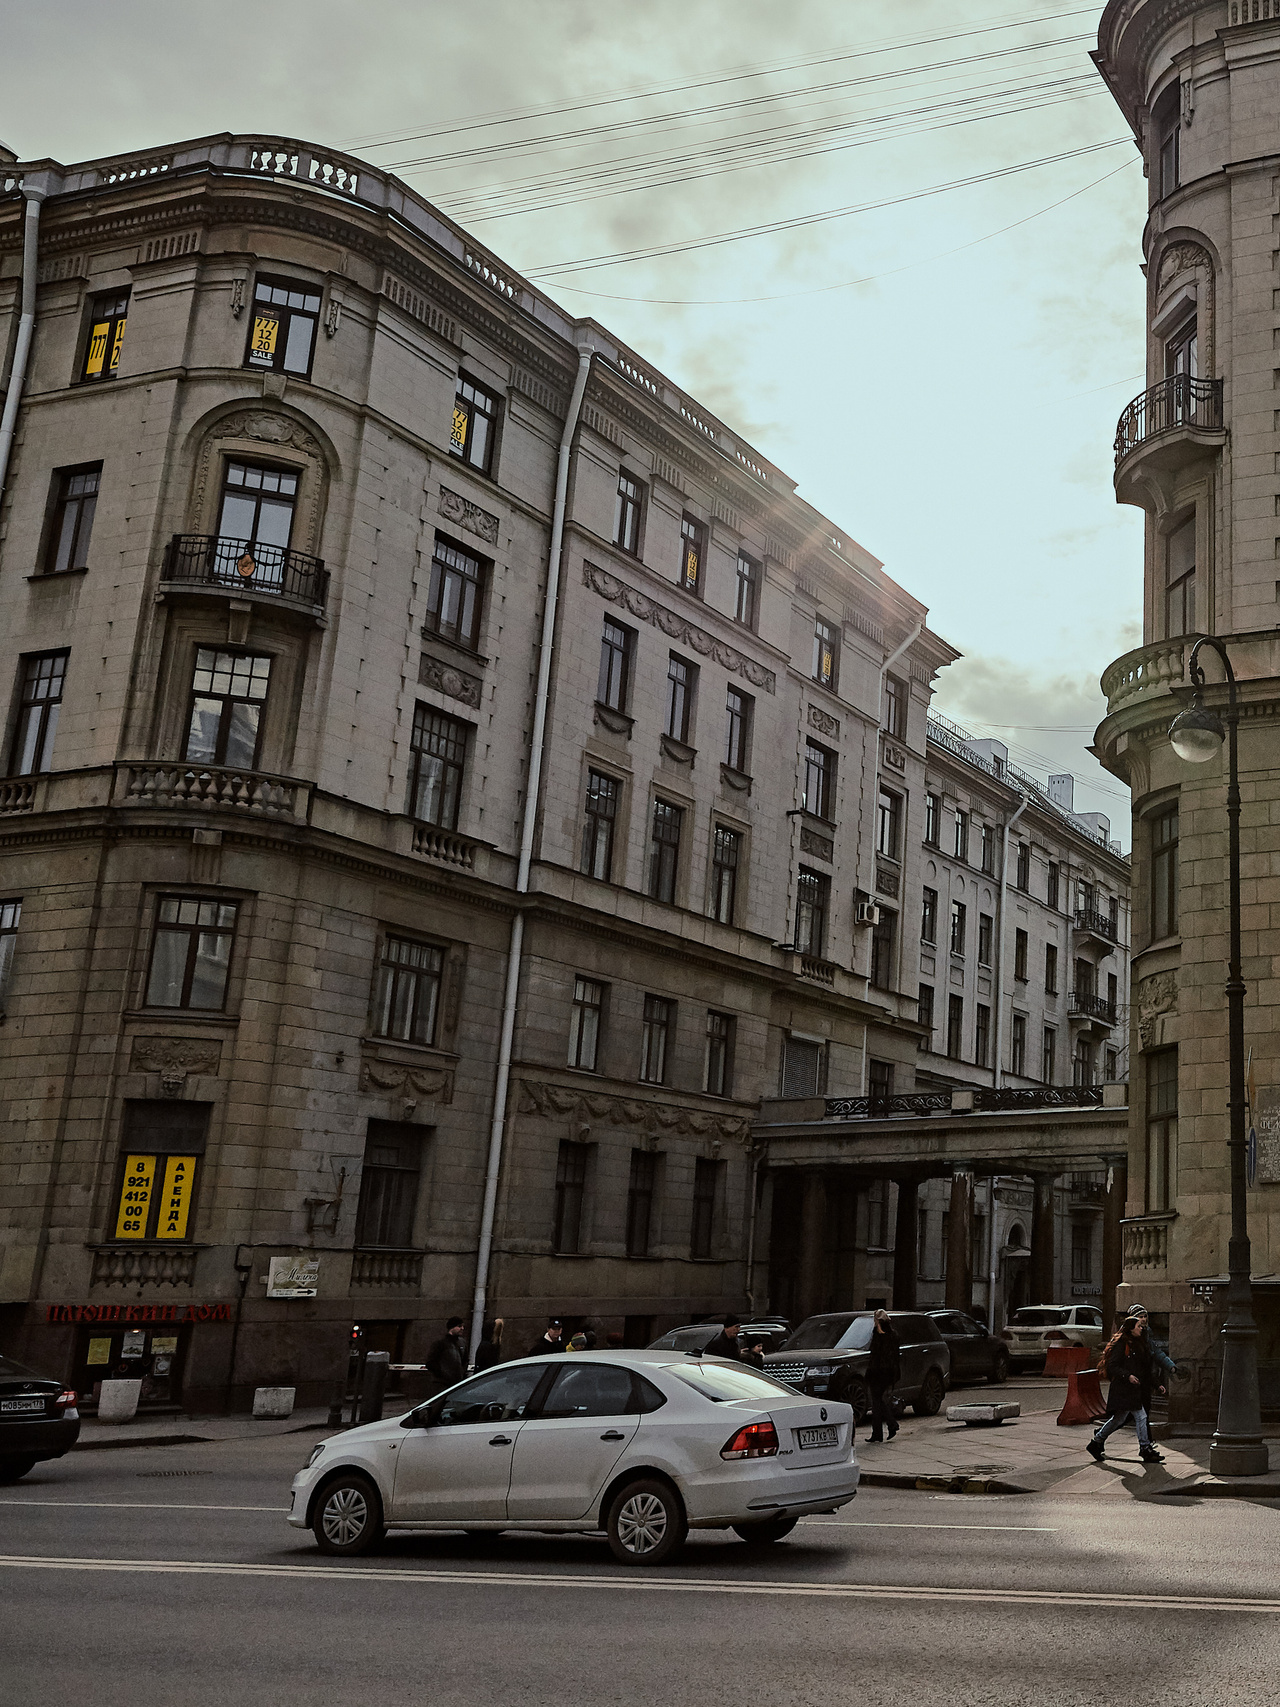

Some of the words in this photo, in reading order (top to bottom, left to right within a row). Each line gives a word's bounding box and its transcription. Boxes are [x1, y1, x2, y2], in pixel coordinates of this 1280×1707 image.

[256, 317, 278, 330] 777
[258, 328, 272, 341] 12
[90, 333, 107, 360] 777
[256, 339, 270, 351] 20
[252, 350, 273, 360] SALE
[454, 408, 468, 423] 77
[450, 427, 462, 441] 20
[451, 437, 464, 451] ALE
[135, 1162, 146, 1173] 8
[127, 1176, 150, 1188] 921
[124, 1191, 149, 1202] 412
[166, 1162, 186, 1232] АРЕНДА
[125, 1205, 143, 1217] 00
[123, 1220, 140, 1231] 65
[46, 1304, 177, 1322] ПЛЮШКИН
[181, 1303, 232, 1323] ДОМ
